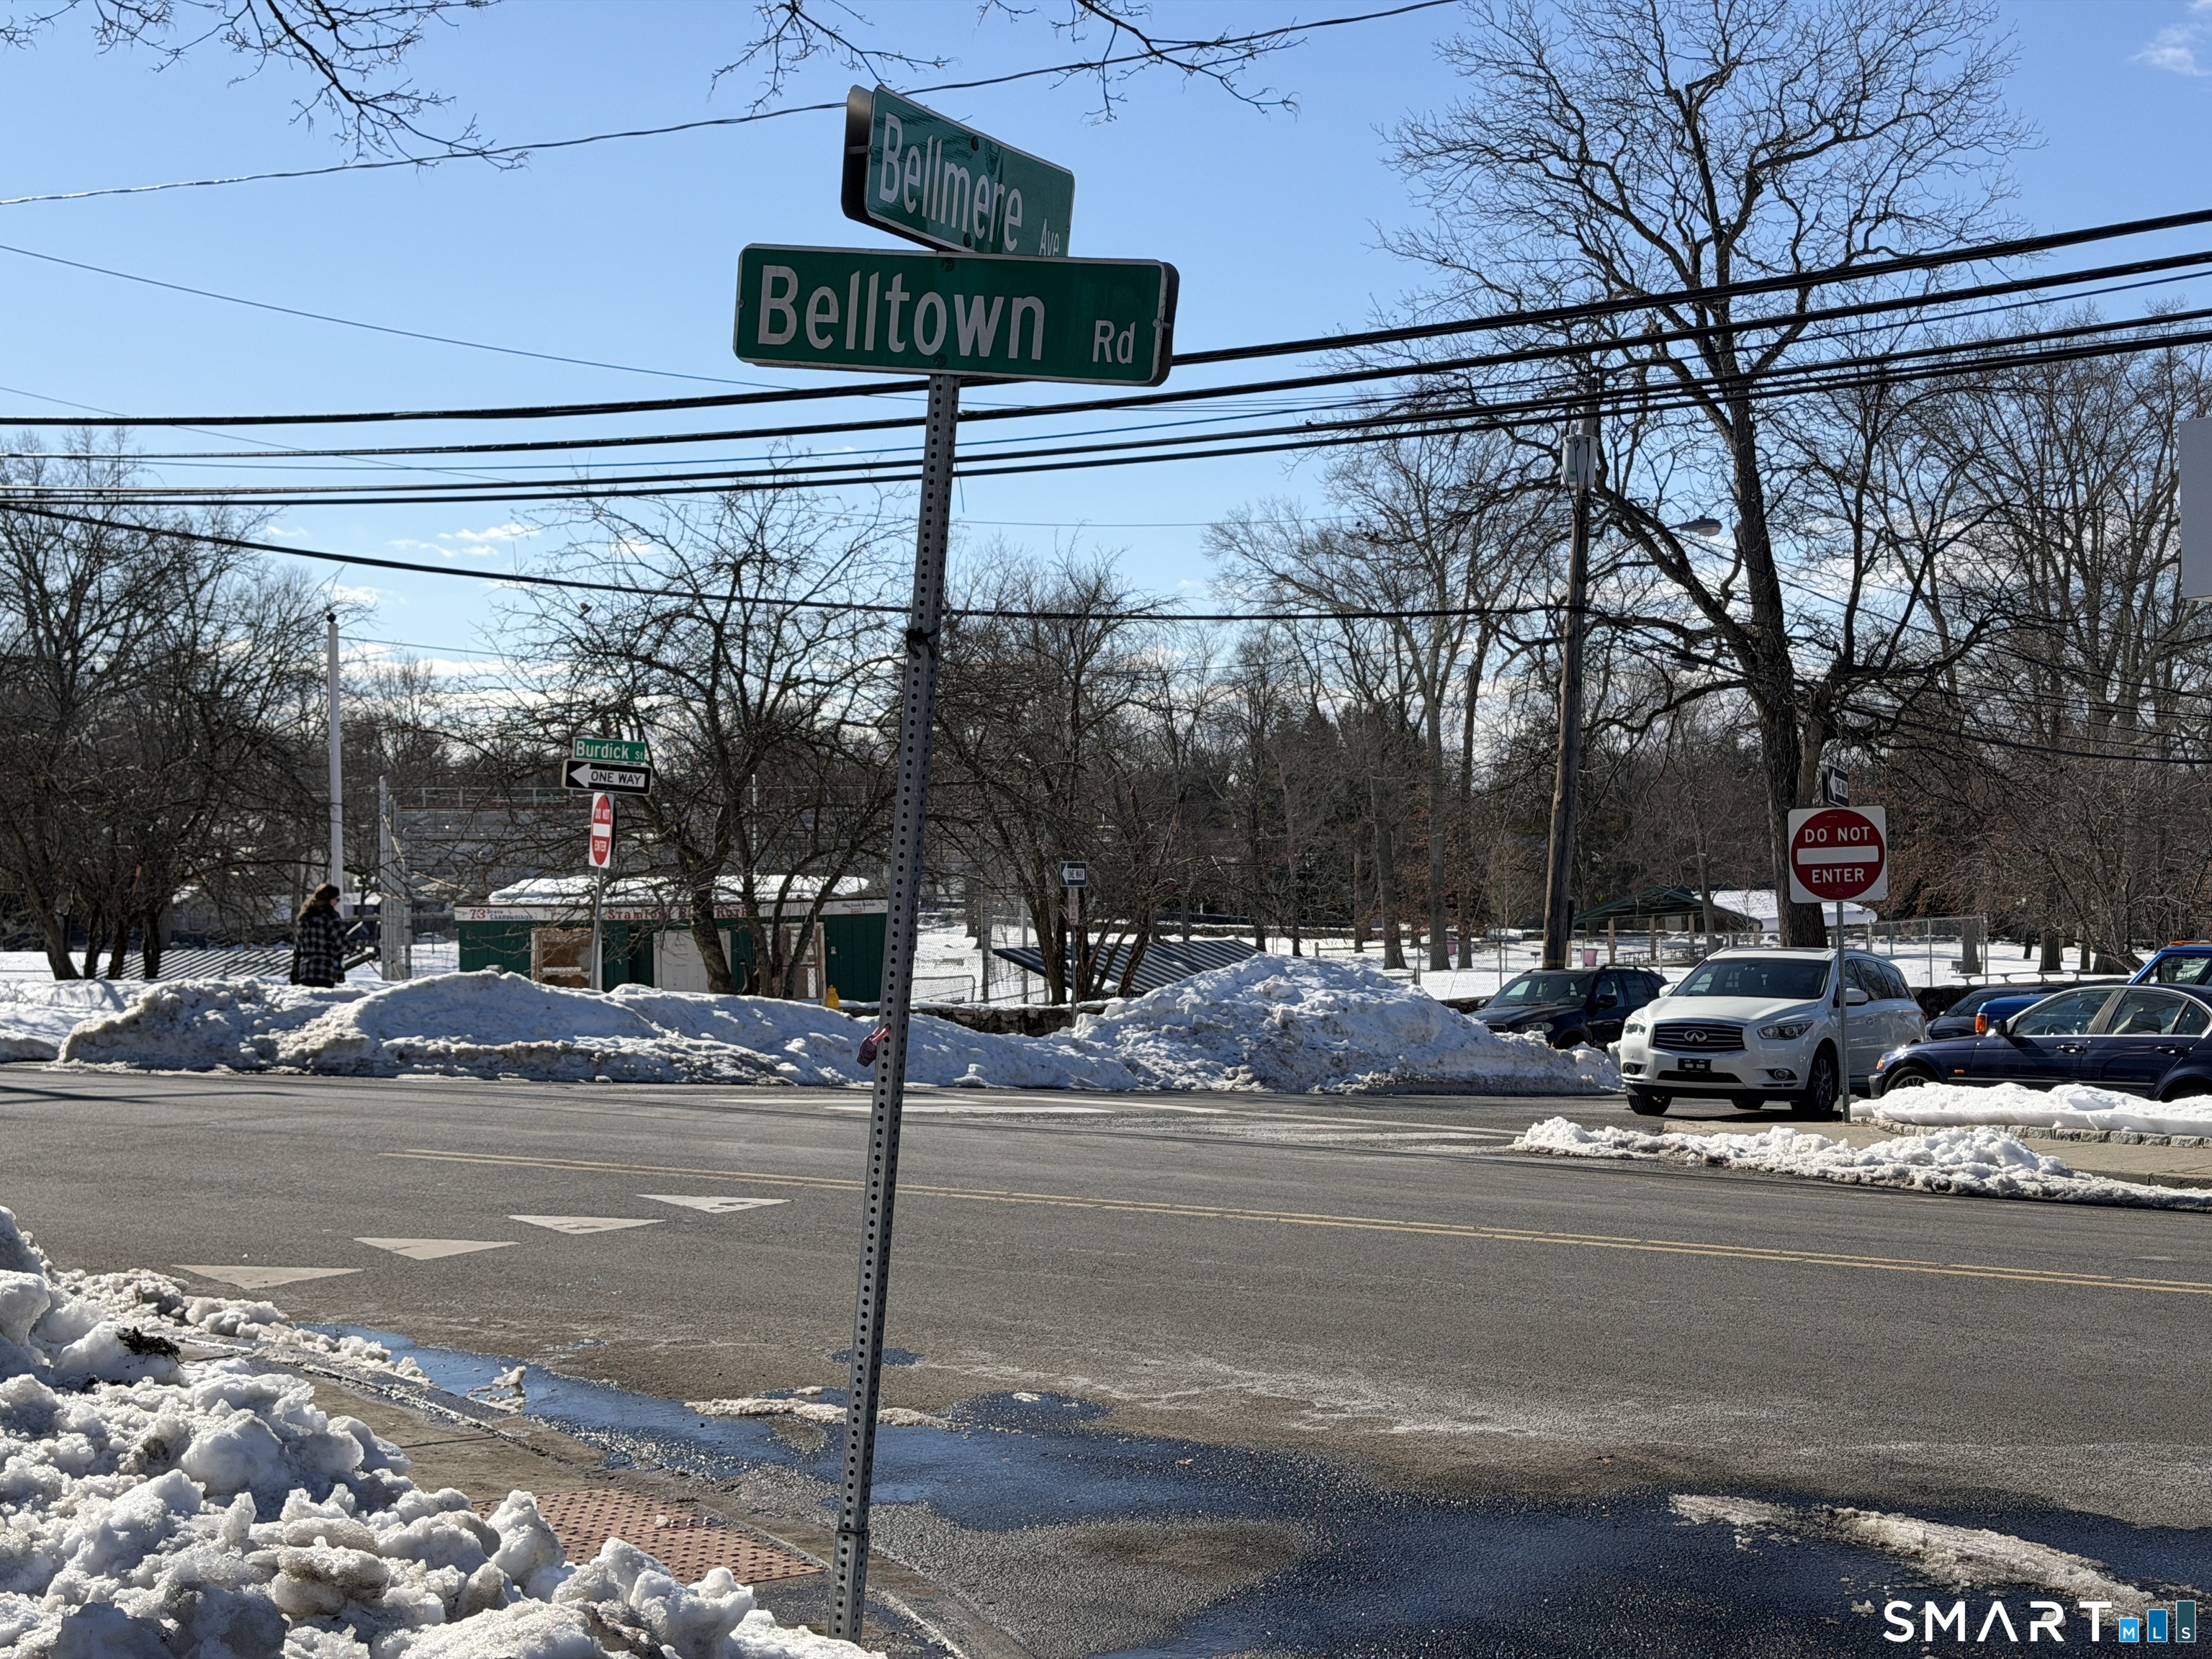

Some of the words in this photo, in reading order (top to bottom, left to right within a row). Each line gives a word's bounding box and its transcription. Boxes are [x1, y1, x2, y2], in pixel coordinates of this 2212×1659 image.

[878, 112, 1024, 252] Bellmere
[1039, 217, 1061, 257] Ave
[757, 265, 1046, 361] Belltown
[1092, 320, 1136, 365] Rd
[576, 740, 629, 760] Burdick
[634, 750, 644, 760] St
[590, 770, 615, 783] ONE
[619, 773, 642, 786] WAY
[1804, 828, 1827, 843] DO
[1838, 826, 1871, 842] NOT
[1812, 868, 1865, 884] ENTER
[469, 908, 486, 920] 73
